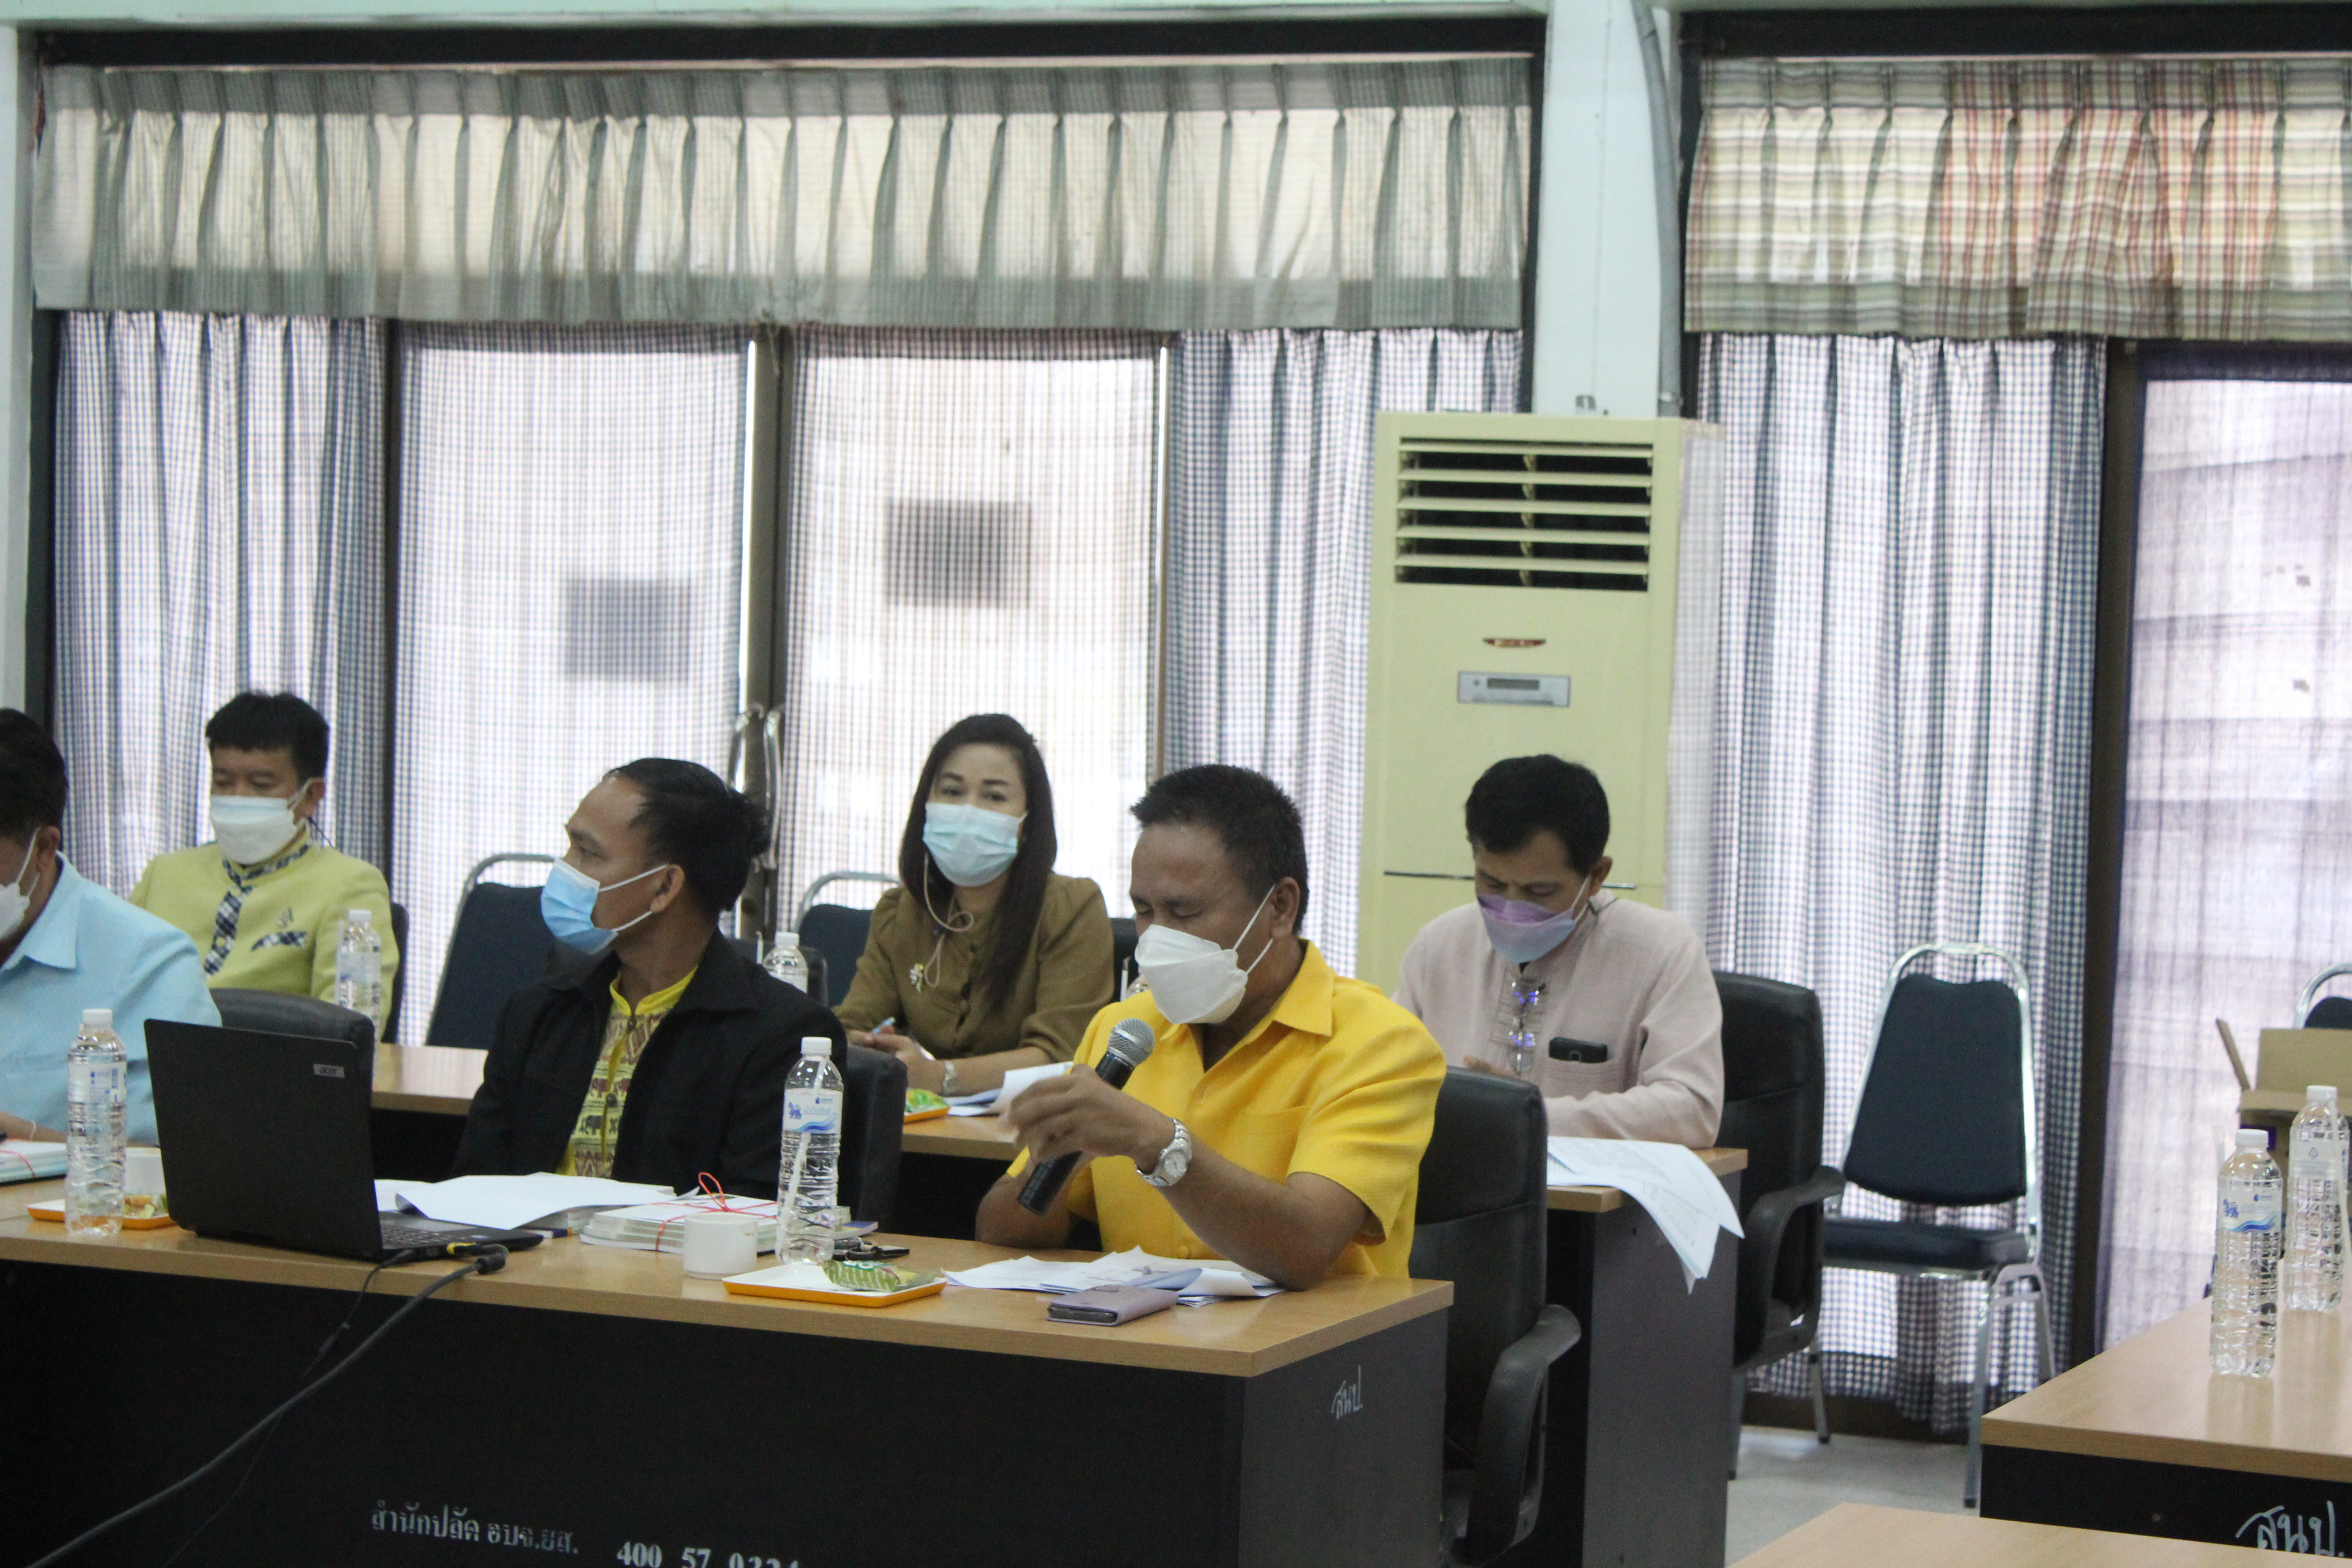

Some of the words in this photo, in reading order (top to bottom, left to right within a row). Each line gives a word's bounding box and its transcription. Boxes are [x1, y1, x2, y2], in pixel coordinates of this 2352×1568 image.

[372, 1499, 480, 1542] สำนักปลัด
[617, 1541, 662, 1568] 400
[682, 1547, 711, 1568] 57
